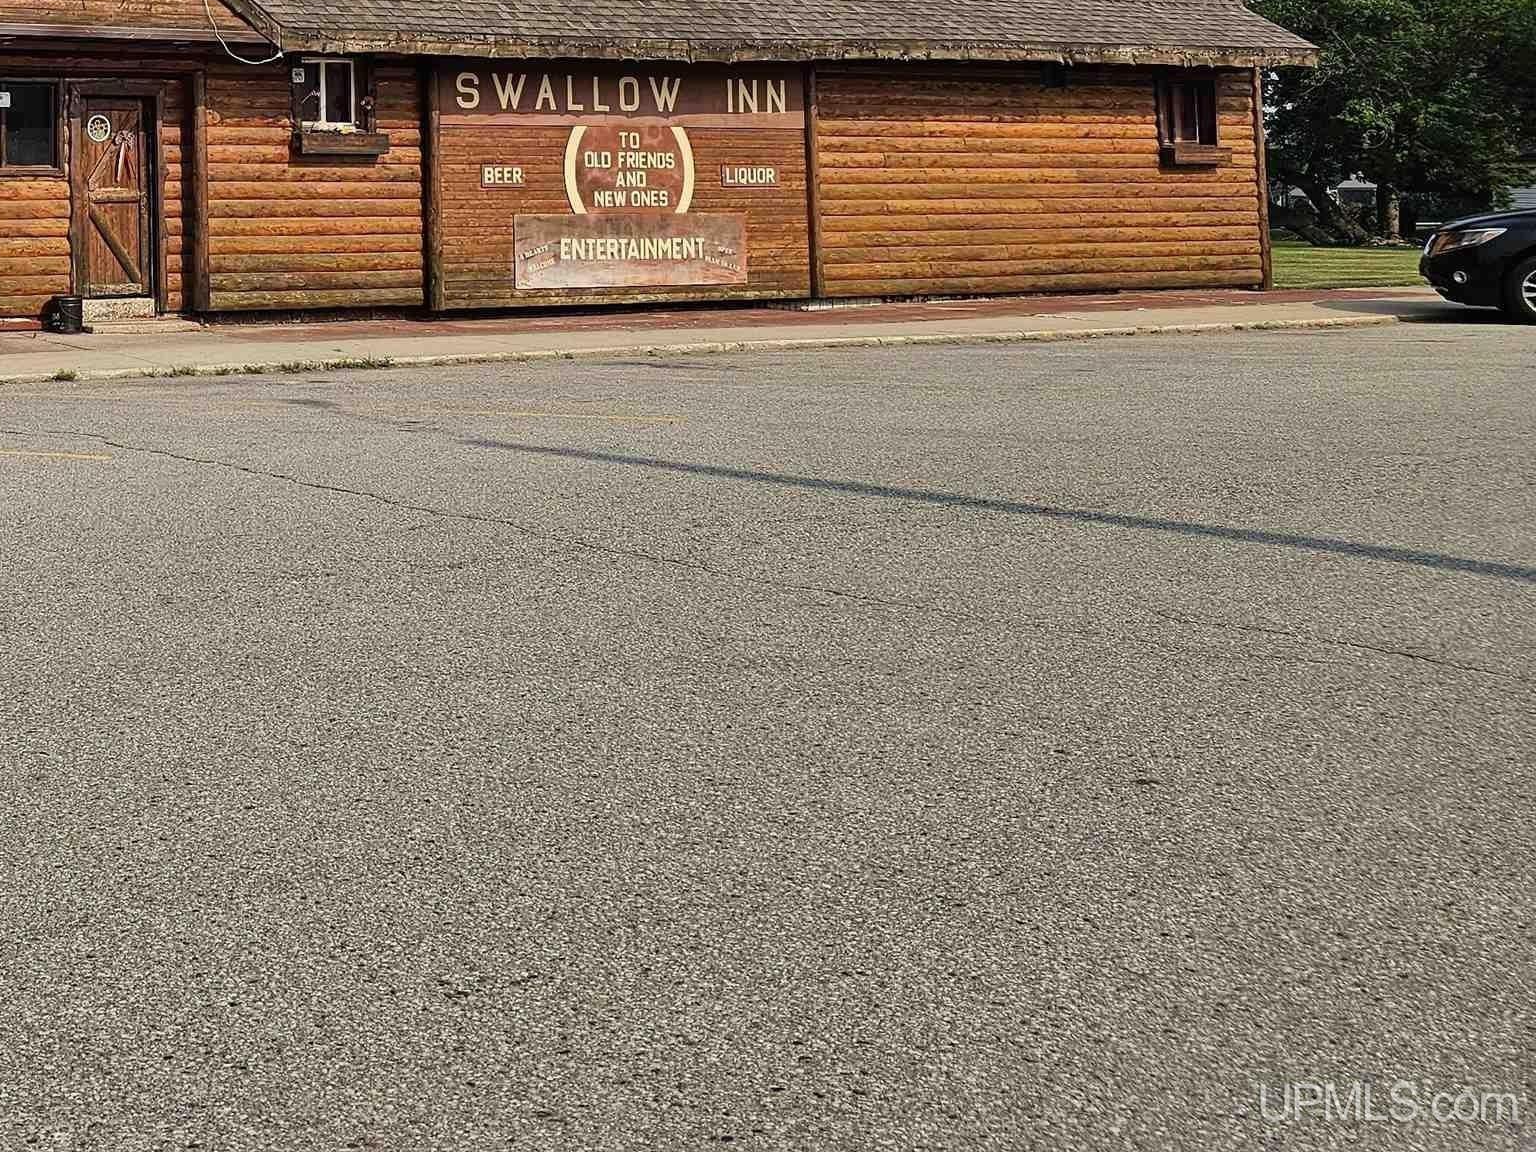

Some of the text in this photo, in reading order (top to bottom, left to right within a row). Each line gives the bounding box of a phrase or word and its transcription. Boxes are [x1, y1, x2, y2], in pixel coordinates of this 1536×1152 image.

[455, 72, 787, 114] SWALLOW INN
[618, 131, 641, 150] TO
[584, 151, 675, 170] OLD FRIENDS
[483, 167, 524, 184] BEER
[615, 170, 647, 188] AND
[725, 167, 776, 184] LIQUOR
[593, 190, 669, 208] NEW ONES
[560, 237, 706, 261] ENTERTAINMENT
